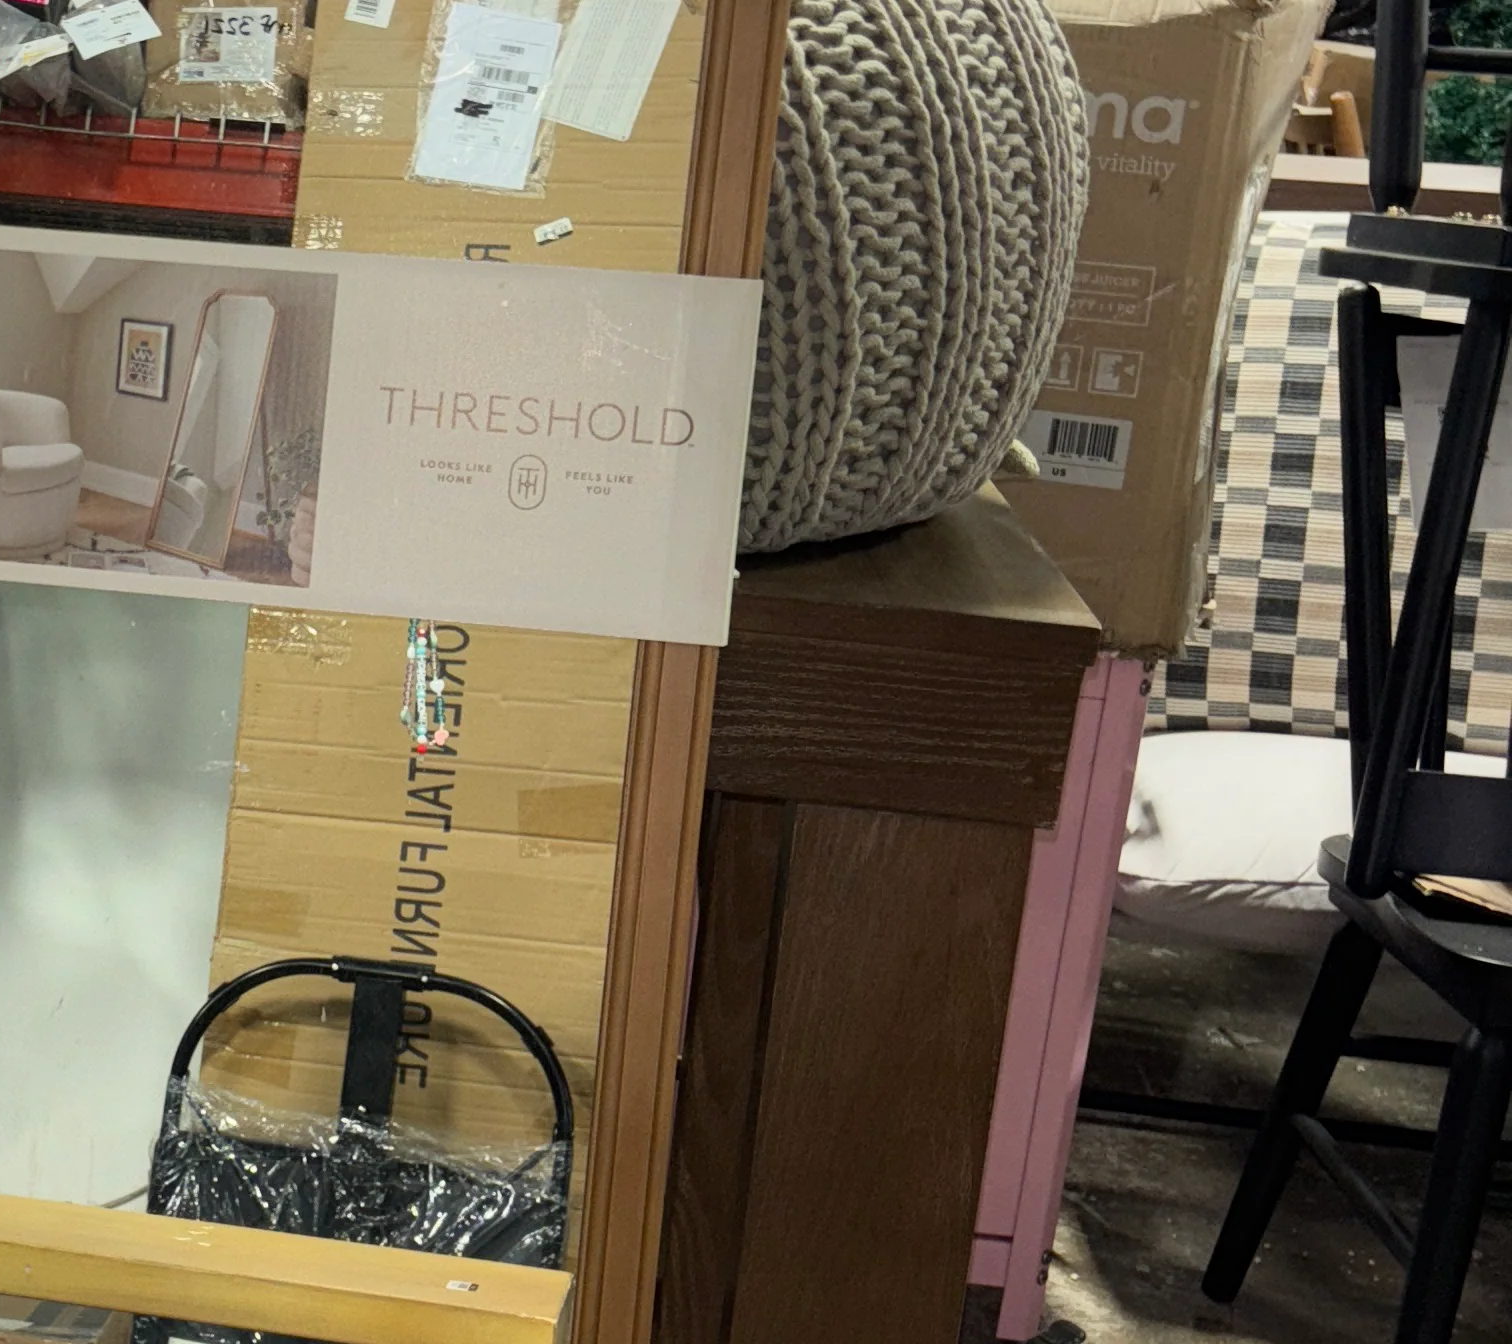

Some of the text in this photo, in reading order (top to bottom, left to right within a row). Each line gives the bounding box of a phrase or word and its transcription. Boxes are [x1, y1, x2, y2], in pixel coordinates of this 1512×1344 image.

[1097, 153, 1177, 183] vitality
[379, 384, 695, 447] THRESHOLD
[419, 459, 493, 474] LOOKS LIKE
[437, 473, 473, 485] HOME
[565, 470, 635, 485] FEELS LIKE
[586, 485, 611, 496] YOU
